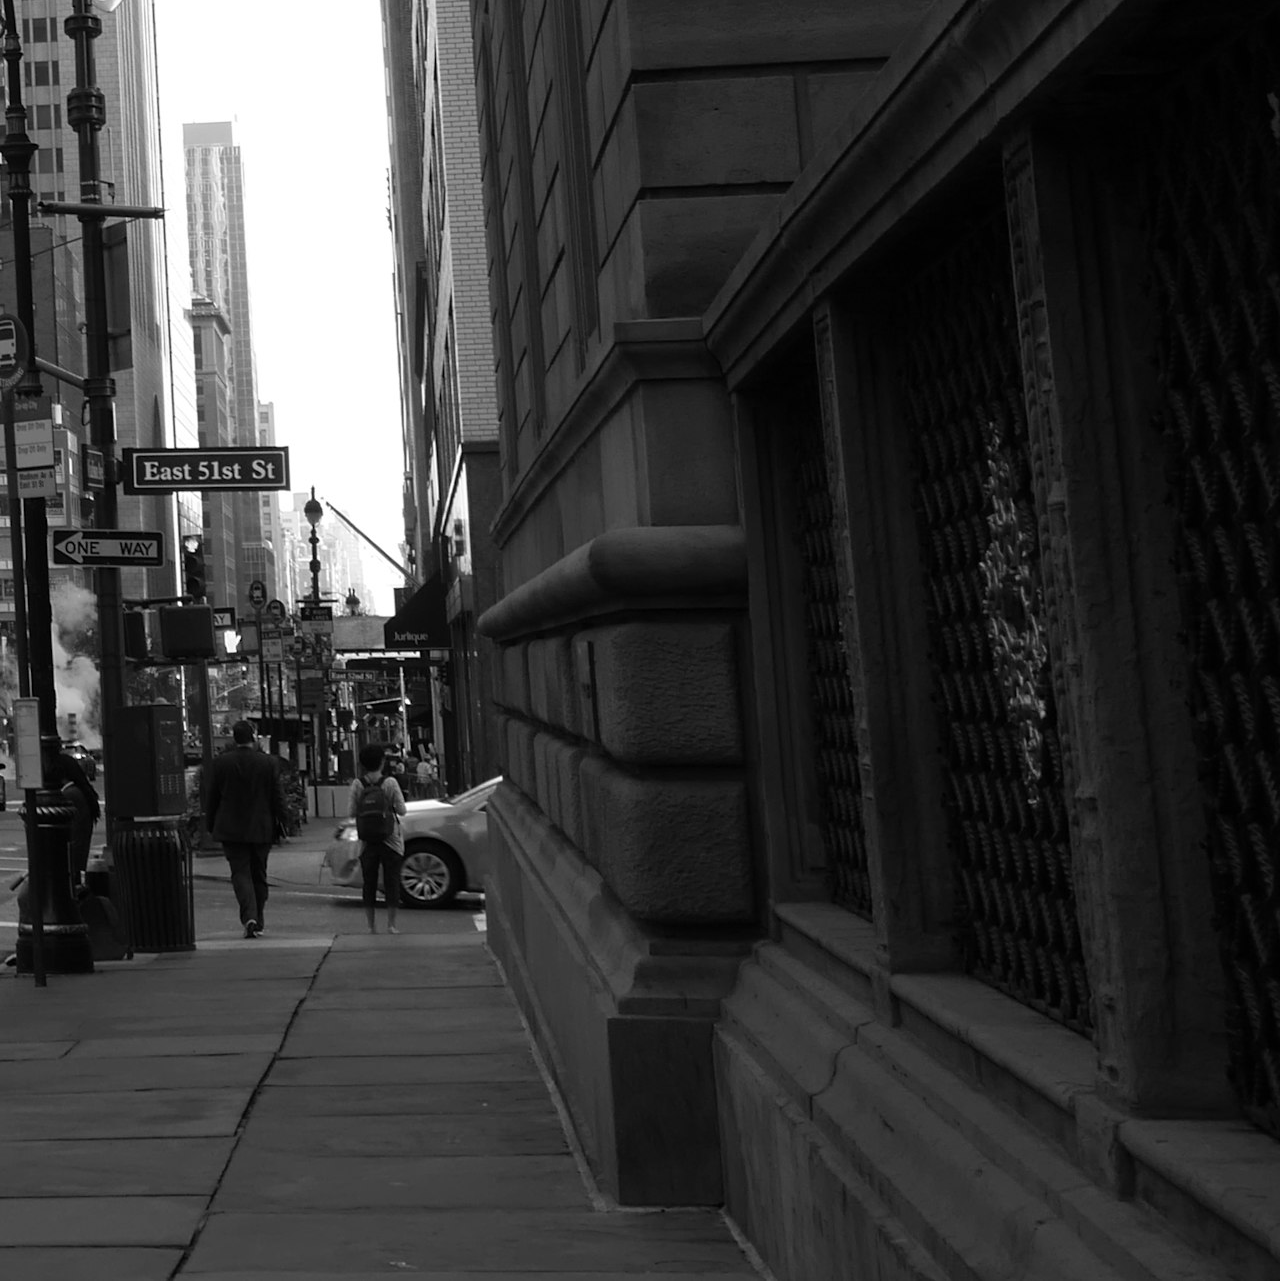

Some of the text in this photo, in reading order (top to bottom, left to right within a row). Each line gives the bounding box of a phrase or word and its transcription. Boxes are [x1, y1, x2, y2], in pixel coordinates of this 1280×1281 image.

[143, 459, 276, 481] East 51st St
[64, 541, 153, 556] ONE WAY
[214, 615, 226, 625] AY
[394, 631, 429, 645] Jurlique
[331, 672, 346, 680] East
